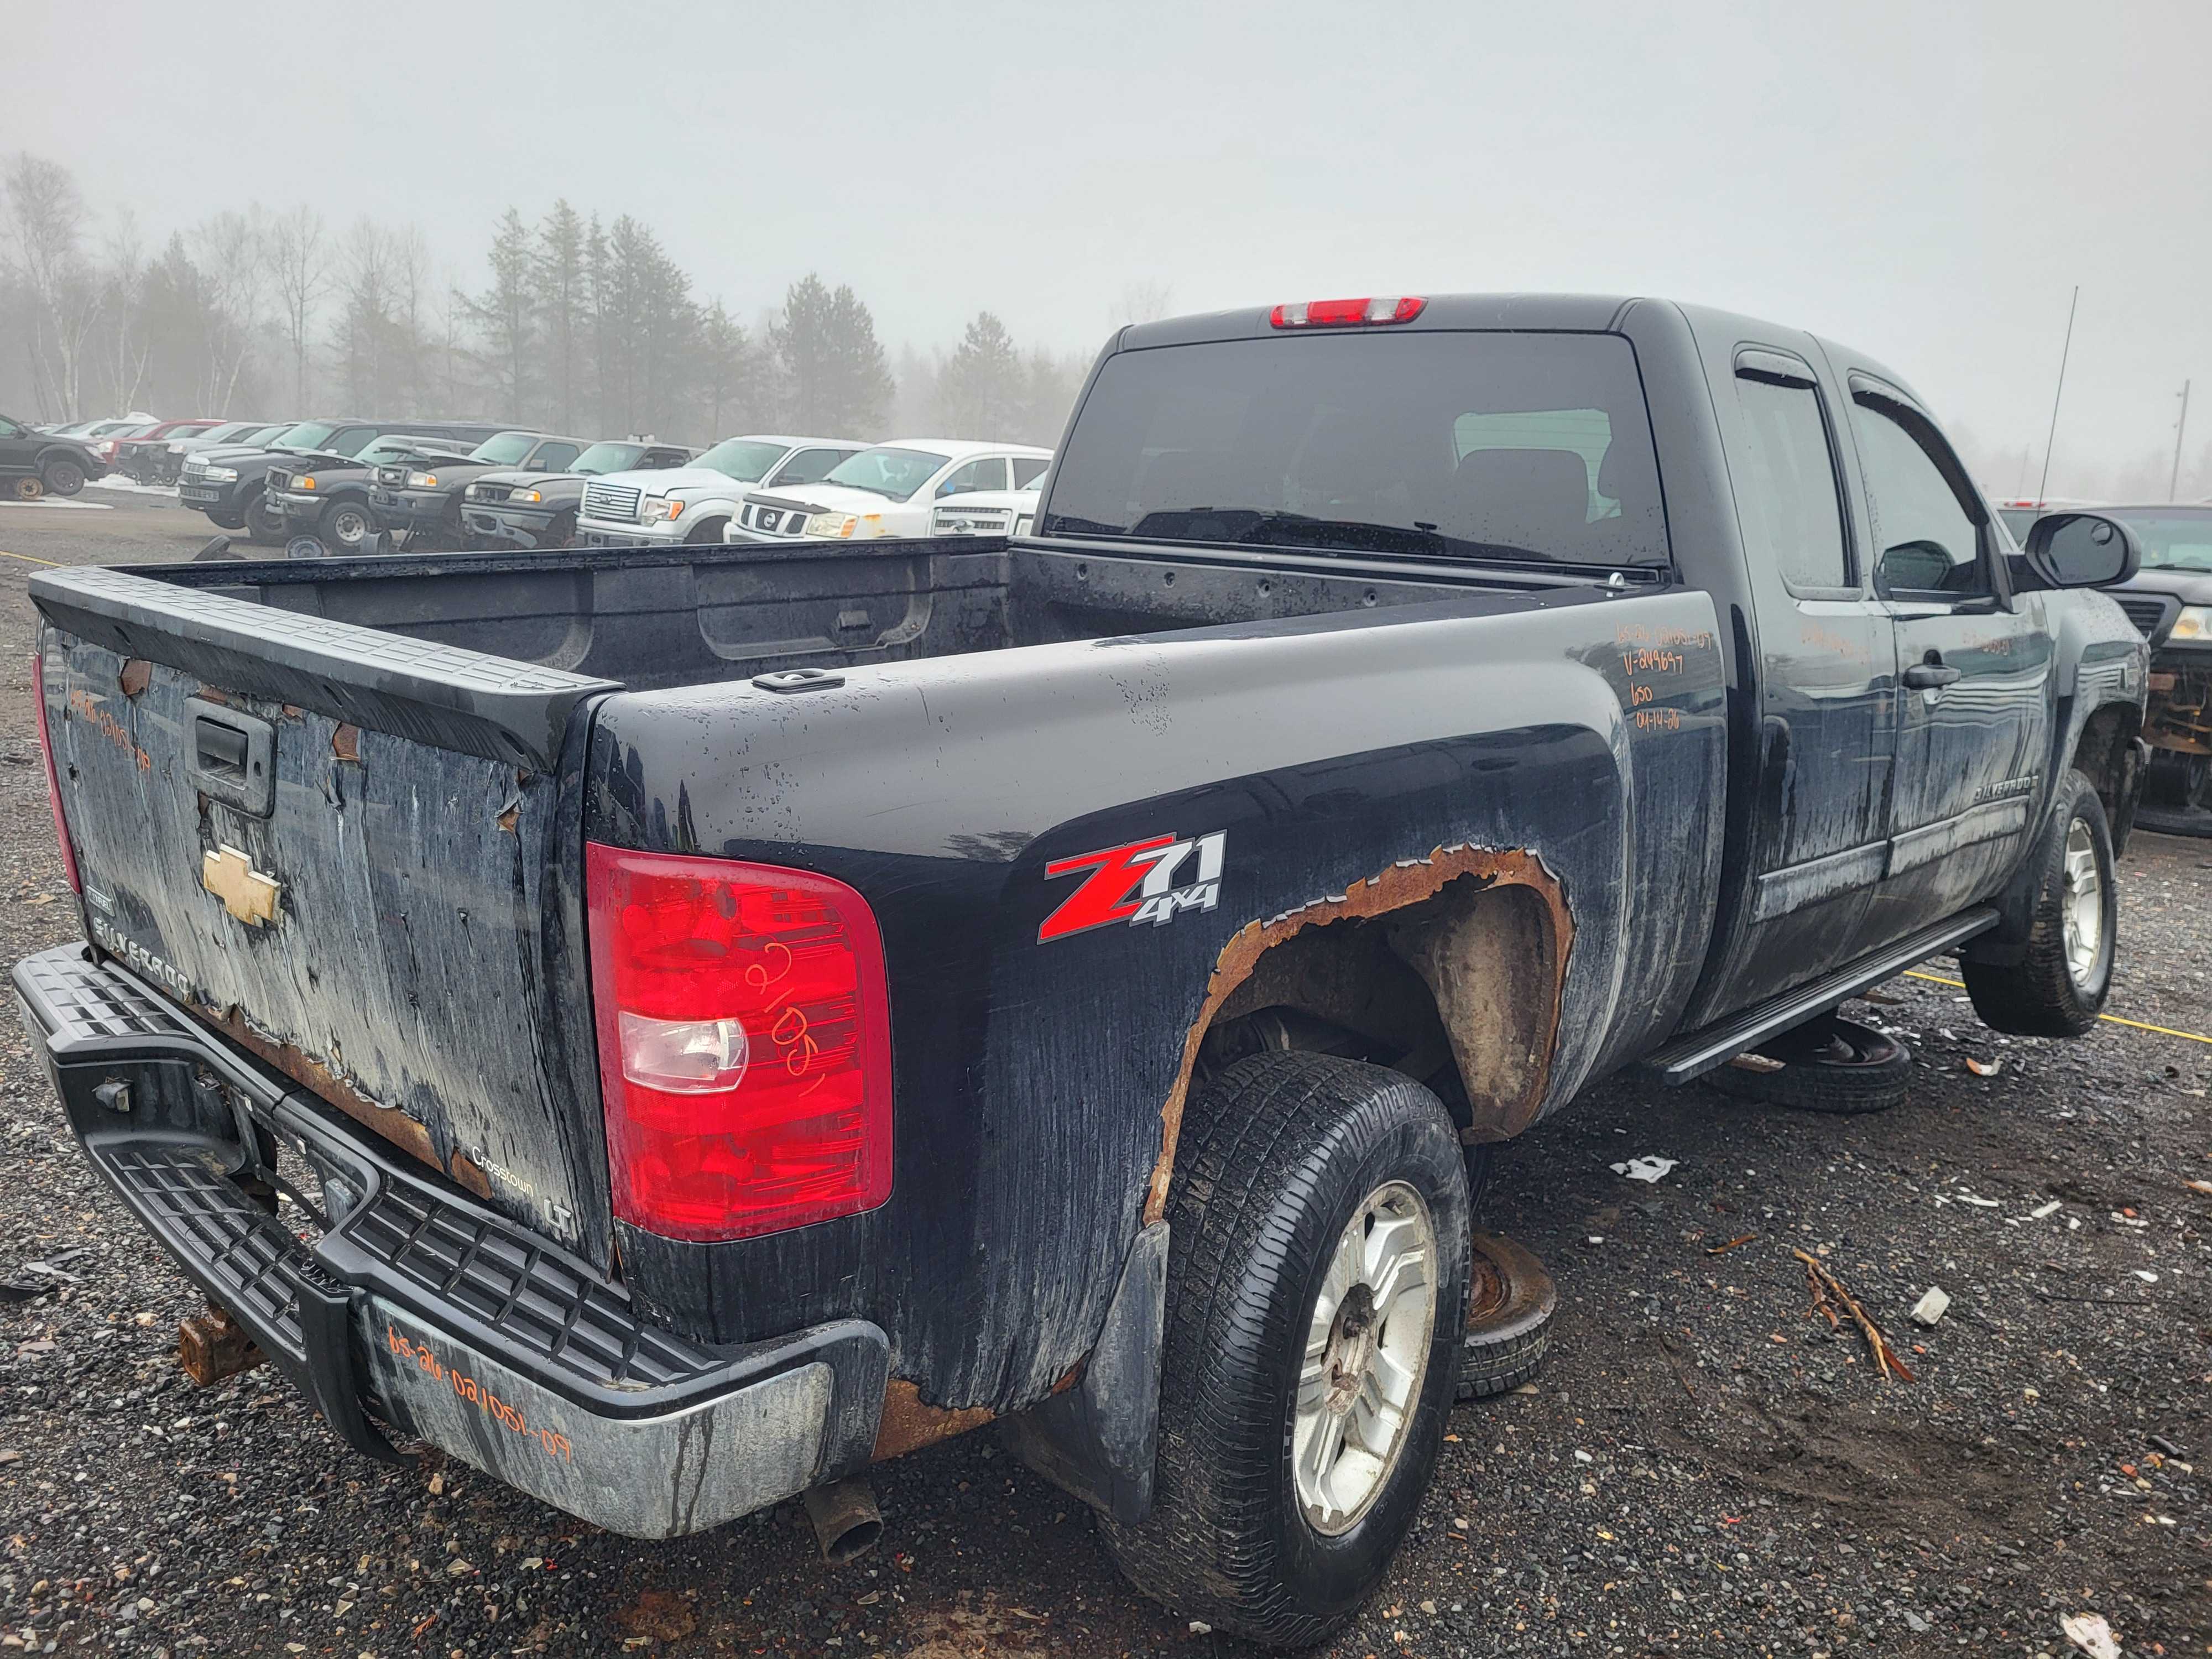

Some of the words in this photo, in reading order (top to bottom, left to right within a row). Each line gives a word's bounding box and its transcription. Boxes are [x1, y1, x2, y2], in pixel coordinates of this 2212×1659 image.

[1039, 831, 1225, 941] Z71
[93, 916, 191, 999] SILVERADO
[472, 1145, 534, 1198] Crosstown
[544, 1198, 573, 1233] LT
